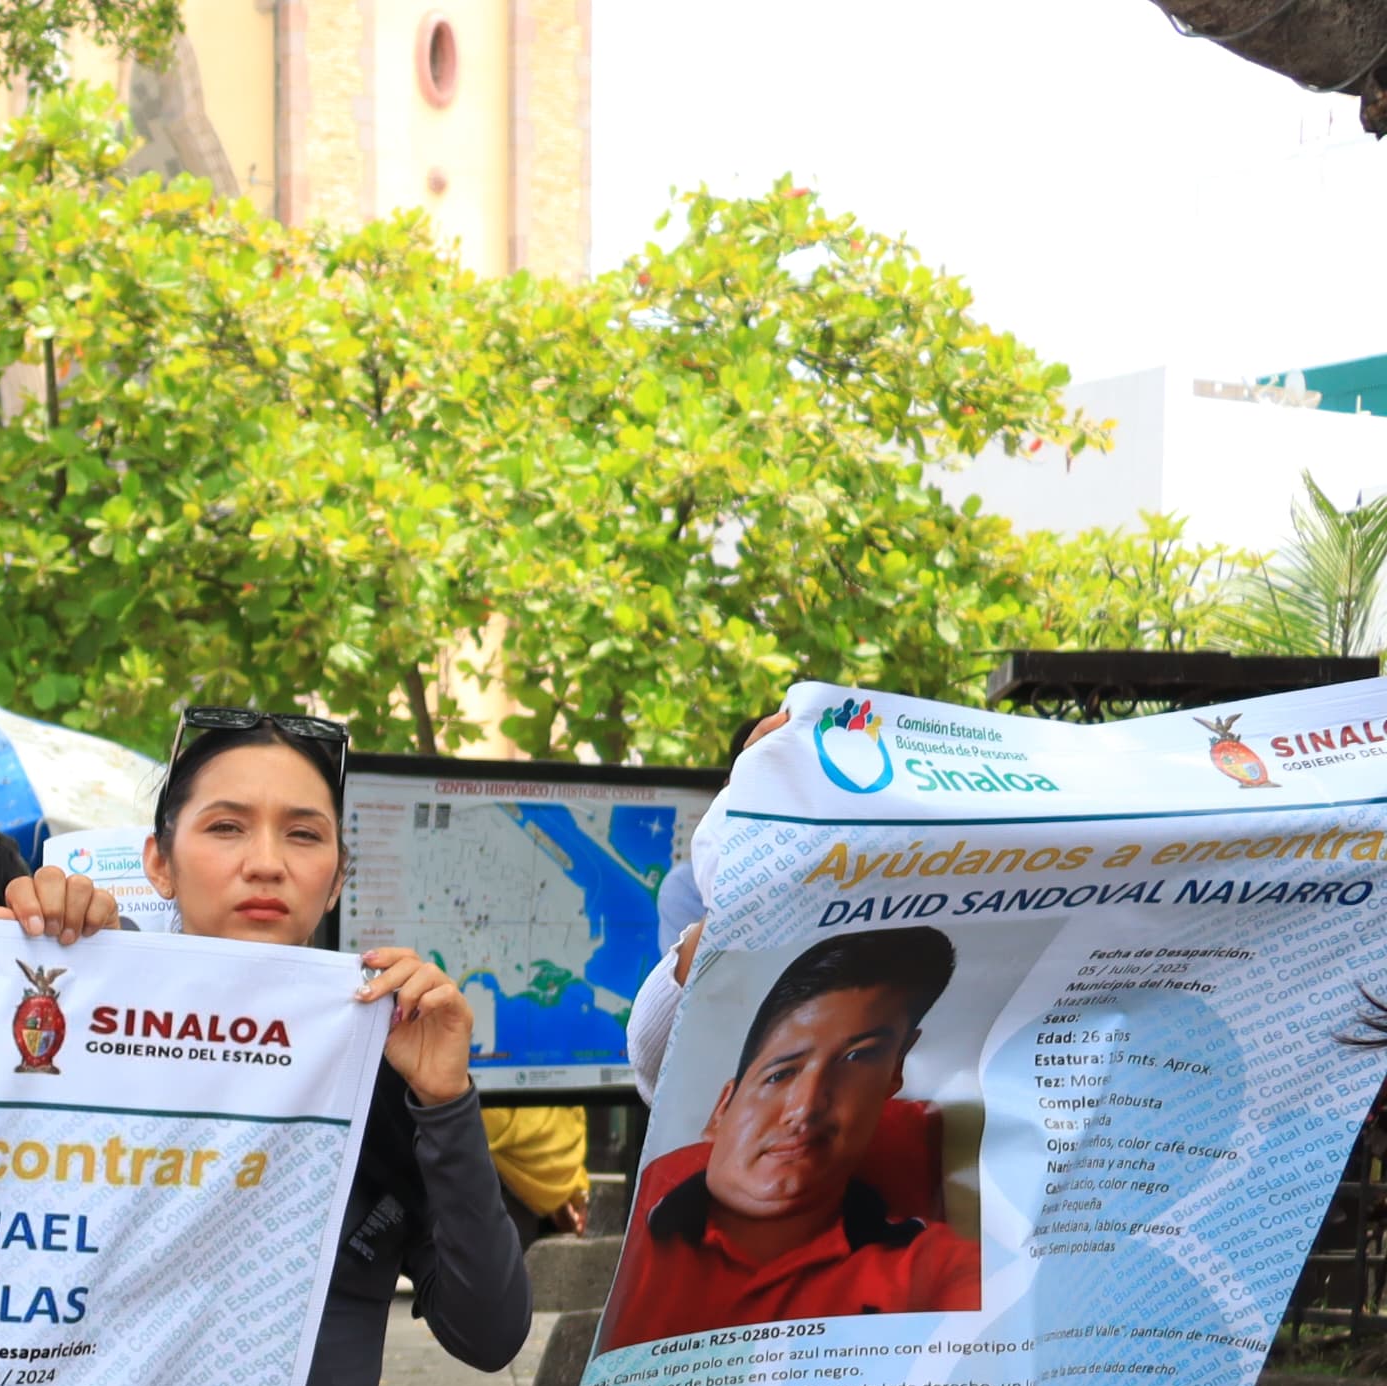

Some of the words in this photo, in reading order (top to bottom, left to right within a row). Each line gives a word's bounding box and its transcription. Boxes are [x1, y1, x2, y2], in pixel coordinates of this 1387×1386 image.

[895, 712, 949, 736] Comisión
[950, 722, 985, 739] Estatal
[986, 729, 1003, 741] de
[895, 734, 955, 758] Búsqueda
[956, 743, 971, 757] de
[974, 745, 1027, 762] Personas
[1283, 752, 1356, 772] GOBIERNO
[1362, 748, 1387, 757] DEL
[435, 781, 482, 794] CENTRO
[905, 757, 1059, 793] Sinaloa
[97, 857, 142, 872] Sinaloa
[803, 840, 1094, 890] Ayúdanos
[1102, 843, 1141, 869] a
[1150, 826, 1387, 863] encontra
[128, 901, 177, 913] SANDOV
[817, 893, 948, 928] DAVID
[952, 880, 1165, 915] SANDOVAL
[1175, 880, 1374, 906] NAVARRO
[87, 1006, 293, 1049] SINALOA
[1037, 1030, 1076, 1045] Edad:
[1081, 1029, 1100, 1043] 26
[85, 1040, 184, 1062] GOBIERNO
[188, 1046, 219, 1062] DEL
[222, 1048, 293, 1067] ESTADO
[235, 1148, 268, 1189] a
[651, 1339, 705, 1356] Cédula:
[709, 1323, 826, 1347] RZS-0280-2025
